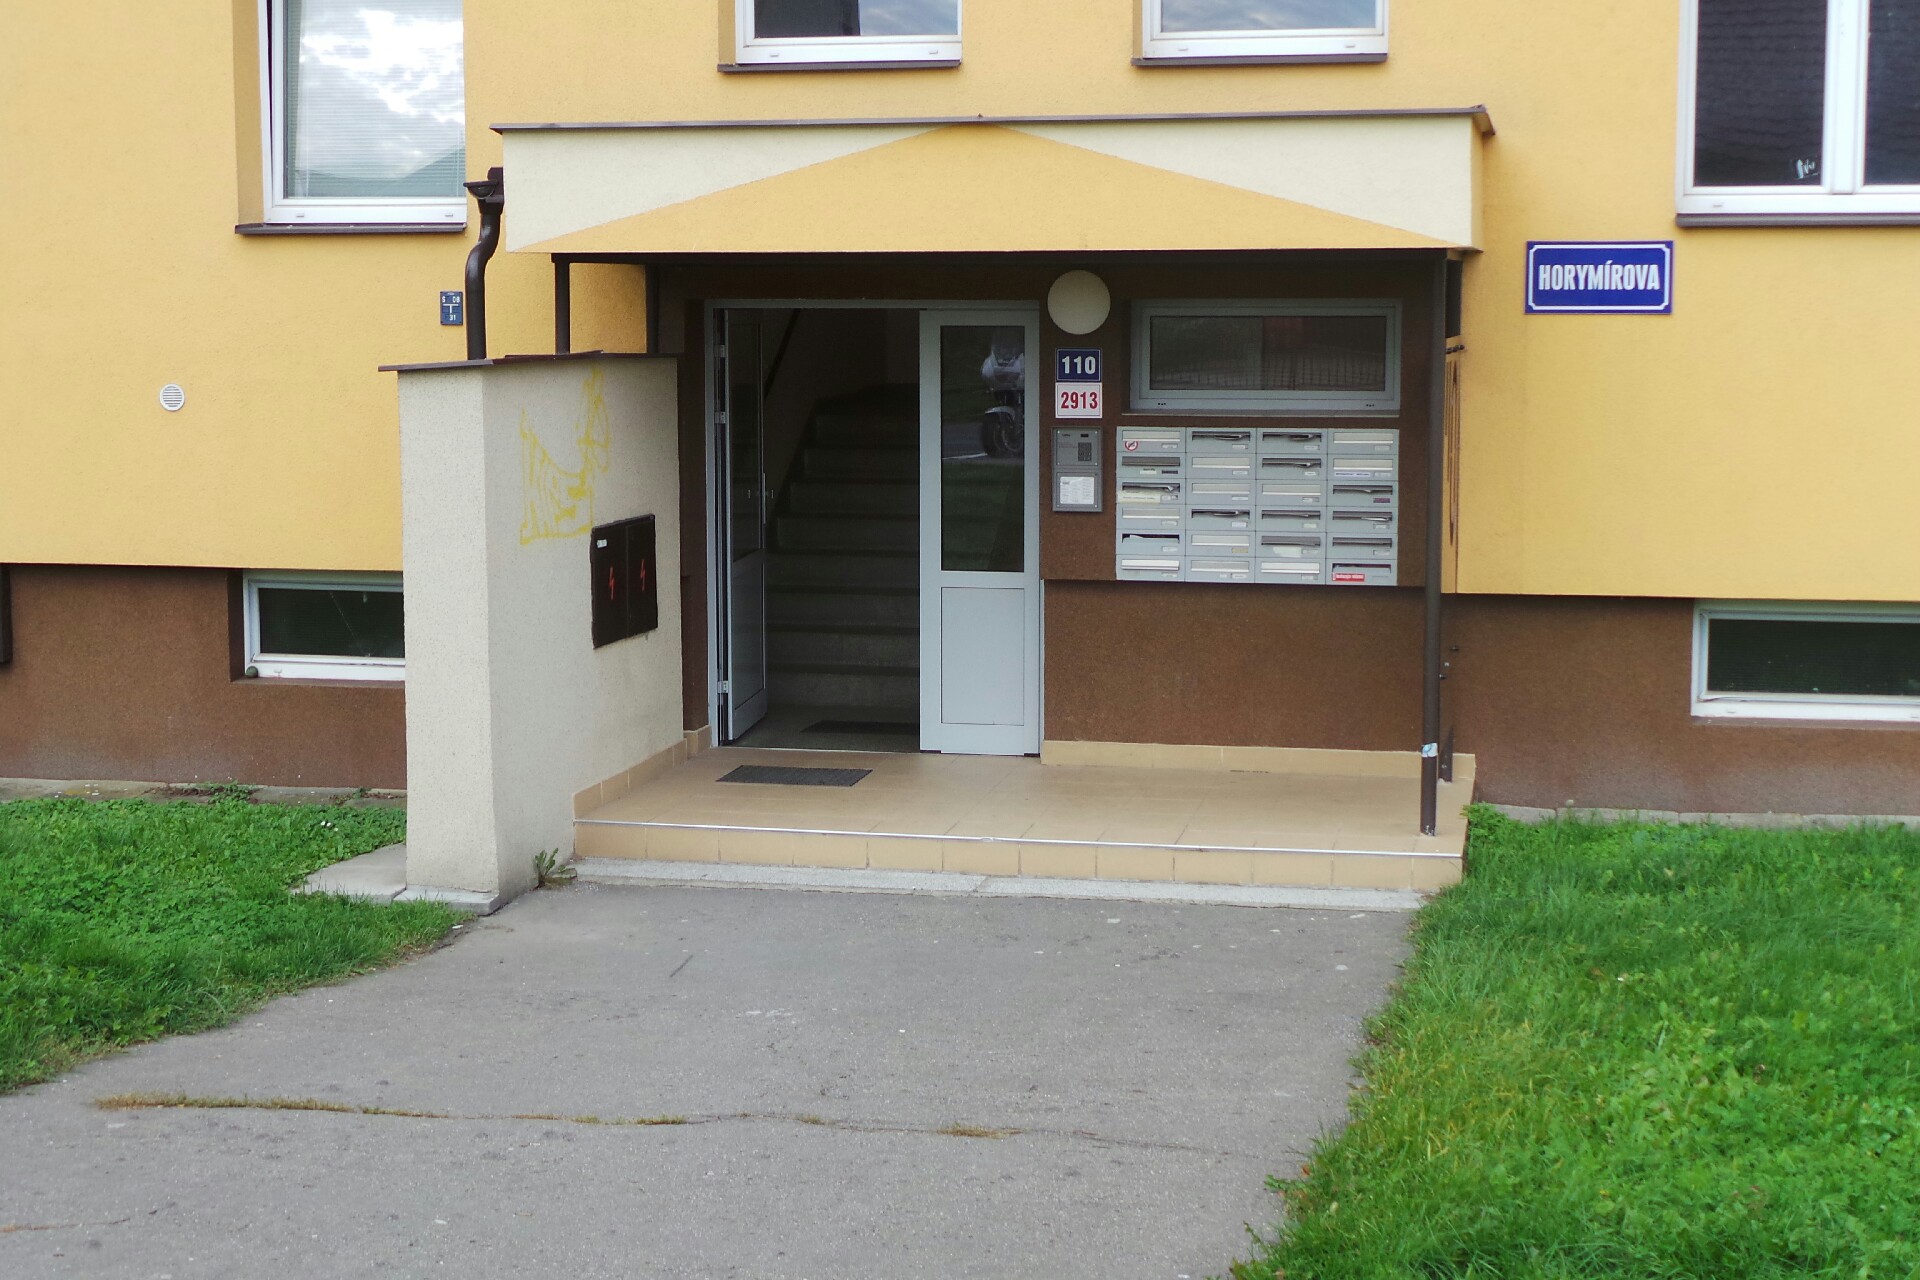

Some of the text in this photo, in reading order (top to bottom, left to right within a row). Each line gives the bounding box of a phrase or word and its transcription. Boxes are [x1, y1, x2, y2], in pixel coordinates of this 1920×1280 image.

[1538, 260, 1660, 290] HORYMÍROVA
[1061, 356, 1096, 375] 110
[1060, 391, 1098, 410] 2913
